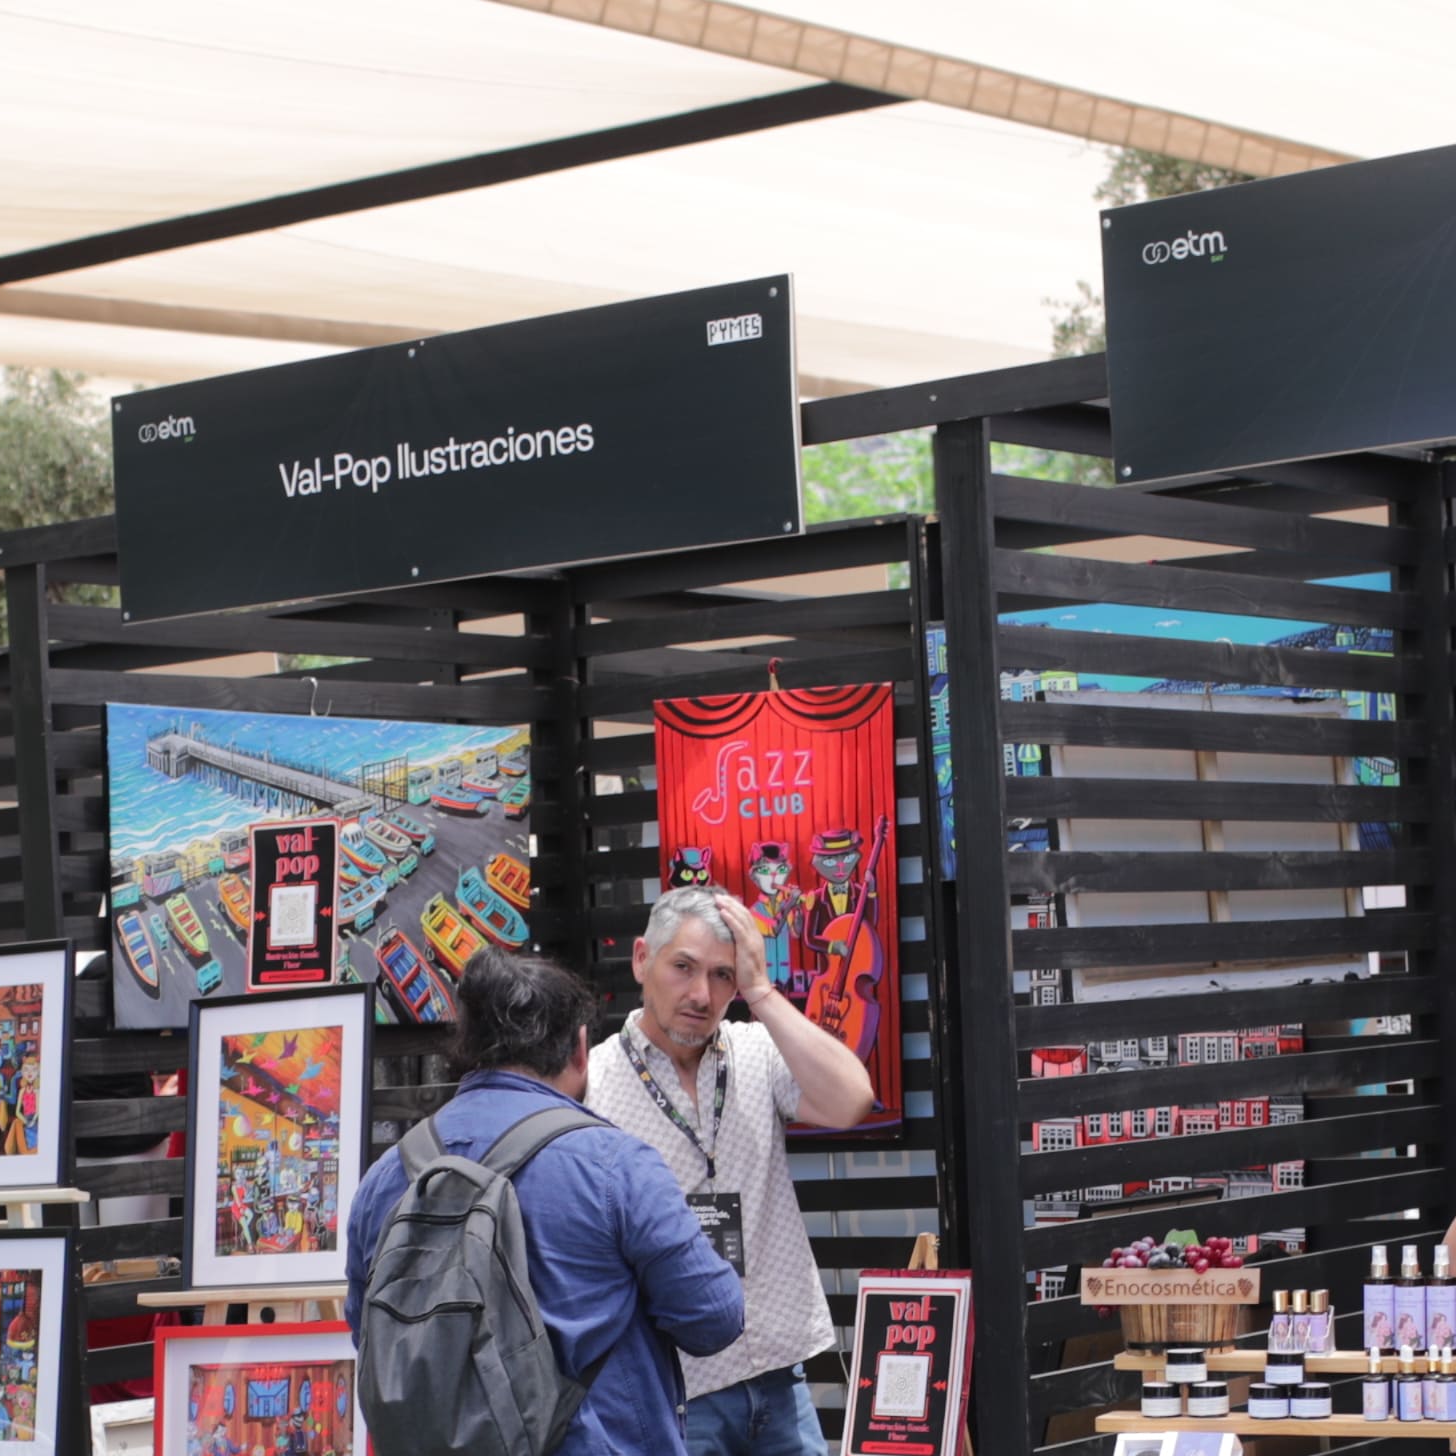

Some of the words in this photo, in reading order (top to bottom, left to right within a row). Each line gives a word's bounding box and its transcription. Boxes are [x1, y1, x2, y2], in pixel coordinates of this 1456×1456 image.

[708, 315, 761, 344] PYMES
[280, 452, 392, 497] Val-Pop
[397, 423, 594, 480] Ilustraciones
[739, 793, 805, 818] CLUB
[275, 855, 320, 883] pop
[1105, 1278, 1237, 1297] Enocosmética
[885, 1324, 937, 1350] pop
